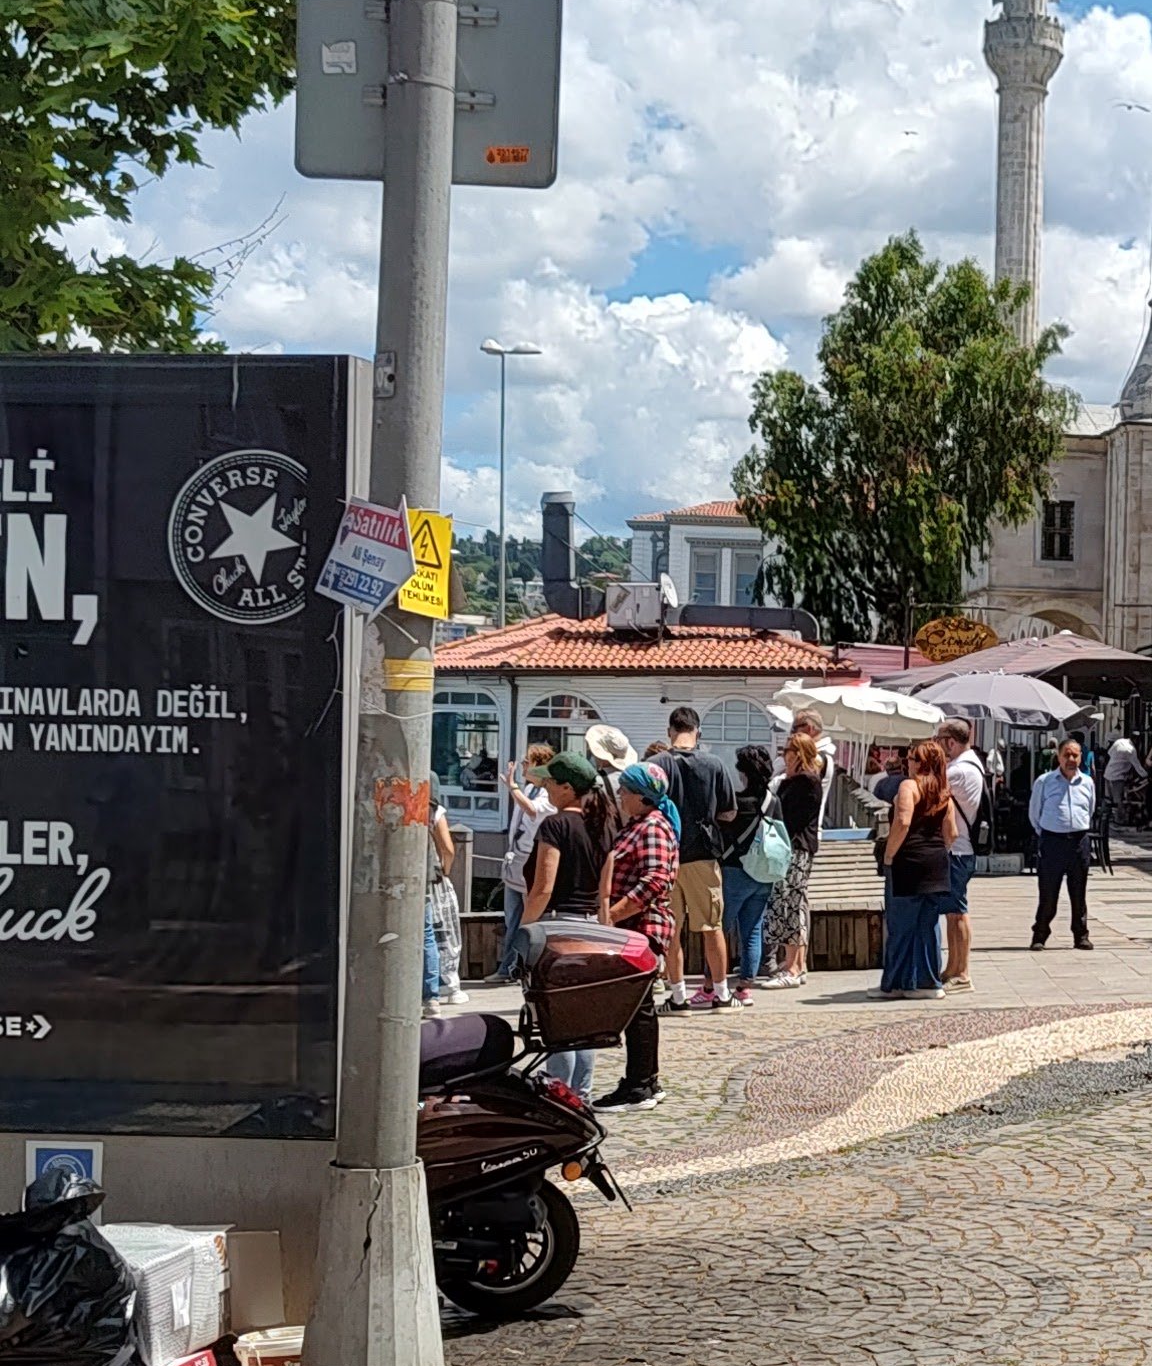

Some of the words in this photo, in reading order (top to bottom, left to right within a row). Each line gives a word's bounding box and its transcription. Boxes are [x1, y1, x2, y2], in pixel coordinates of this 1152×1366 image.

[0, 448, 55, 502] Lİ
[184, 467, 278, 563] CONVERSE
[353, 509, 403, 546] Satılık
[0, 513, 98, 645] N,
[237, 584, 287, 608] ALL
[157, 684, 248, 724] DEĞİL,
[29, 723, 200, 754] YANINDAYIM.
[0, 820, 89, 875] LER,
[0, 1016, 22, 1036] E
